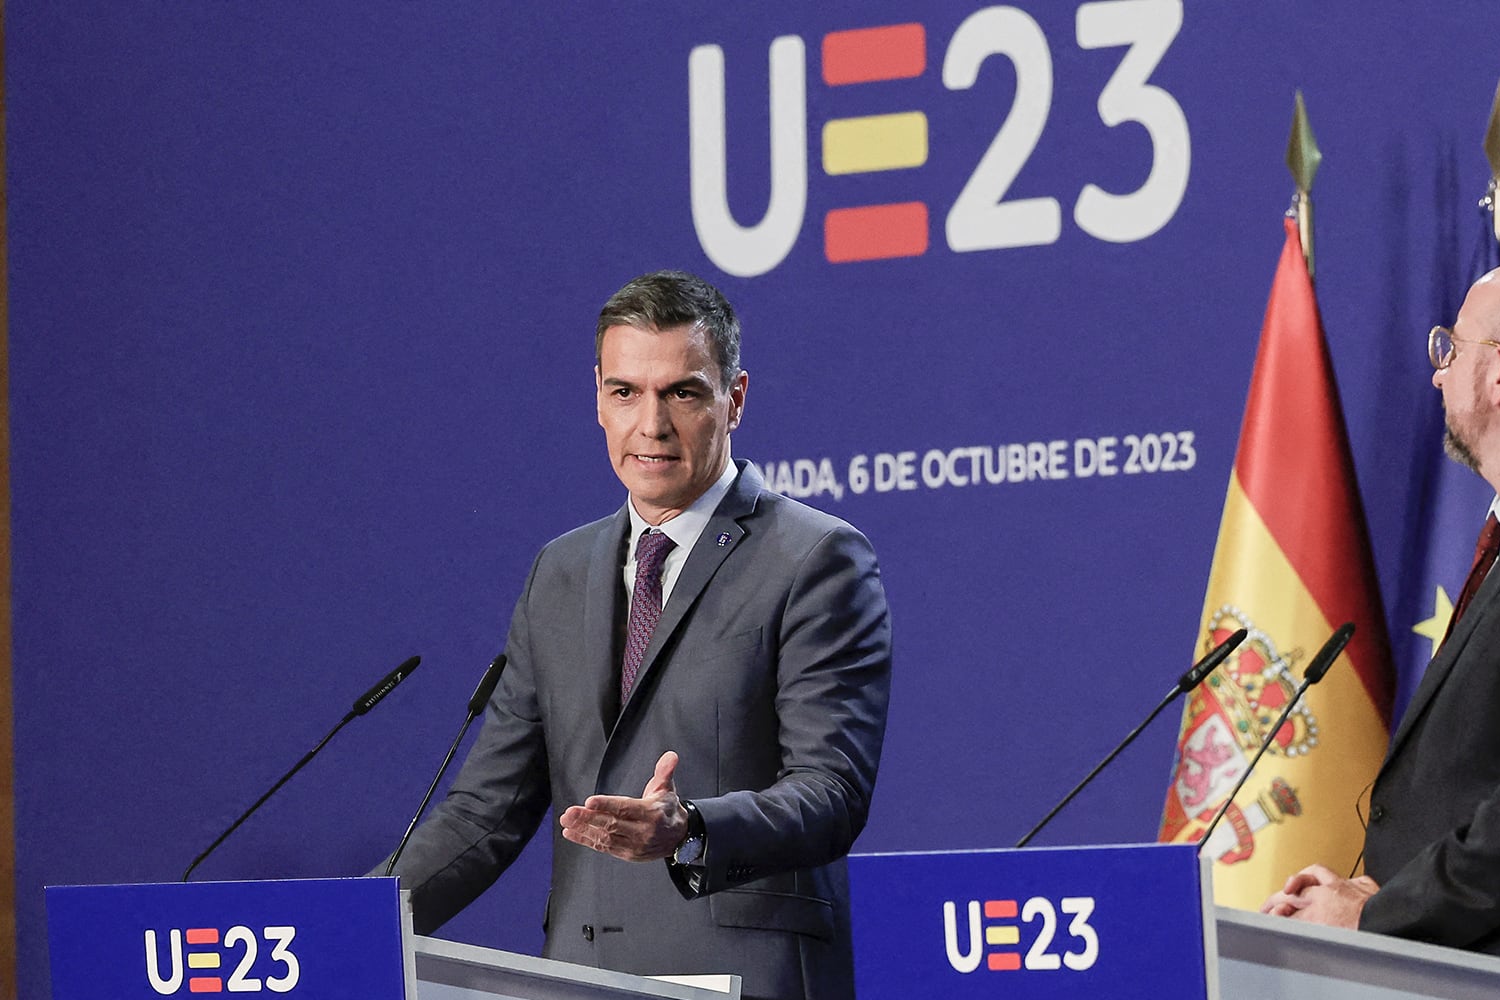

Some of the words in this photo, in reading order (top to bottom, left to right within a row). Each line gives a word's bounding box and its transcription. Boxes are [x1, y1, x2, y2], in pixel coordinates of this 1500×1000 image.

[688, 0, 1192, 278] UE23
[755, 457, 844, 501] NADA,
[848, 454, 870, 494] 6
[874, 451, 918, 492] DE
[921, 440, 1069, 489] OCTUBRE
[1074, 436, 1119, 478] DE
[1123, 430, 1197, 475] 2023
[144, 925, 300, 995] UE23
[943, 896, 1099, 973] UE23
